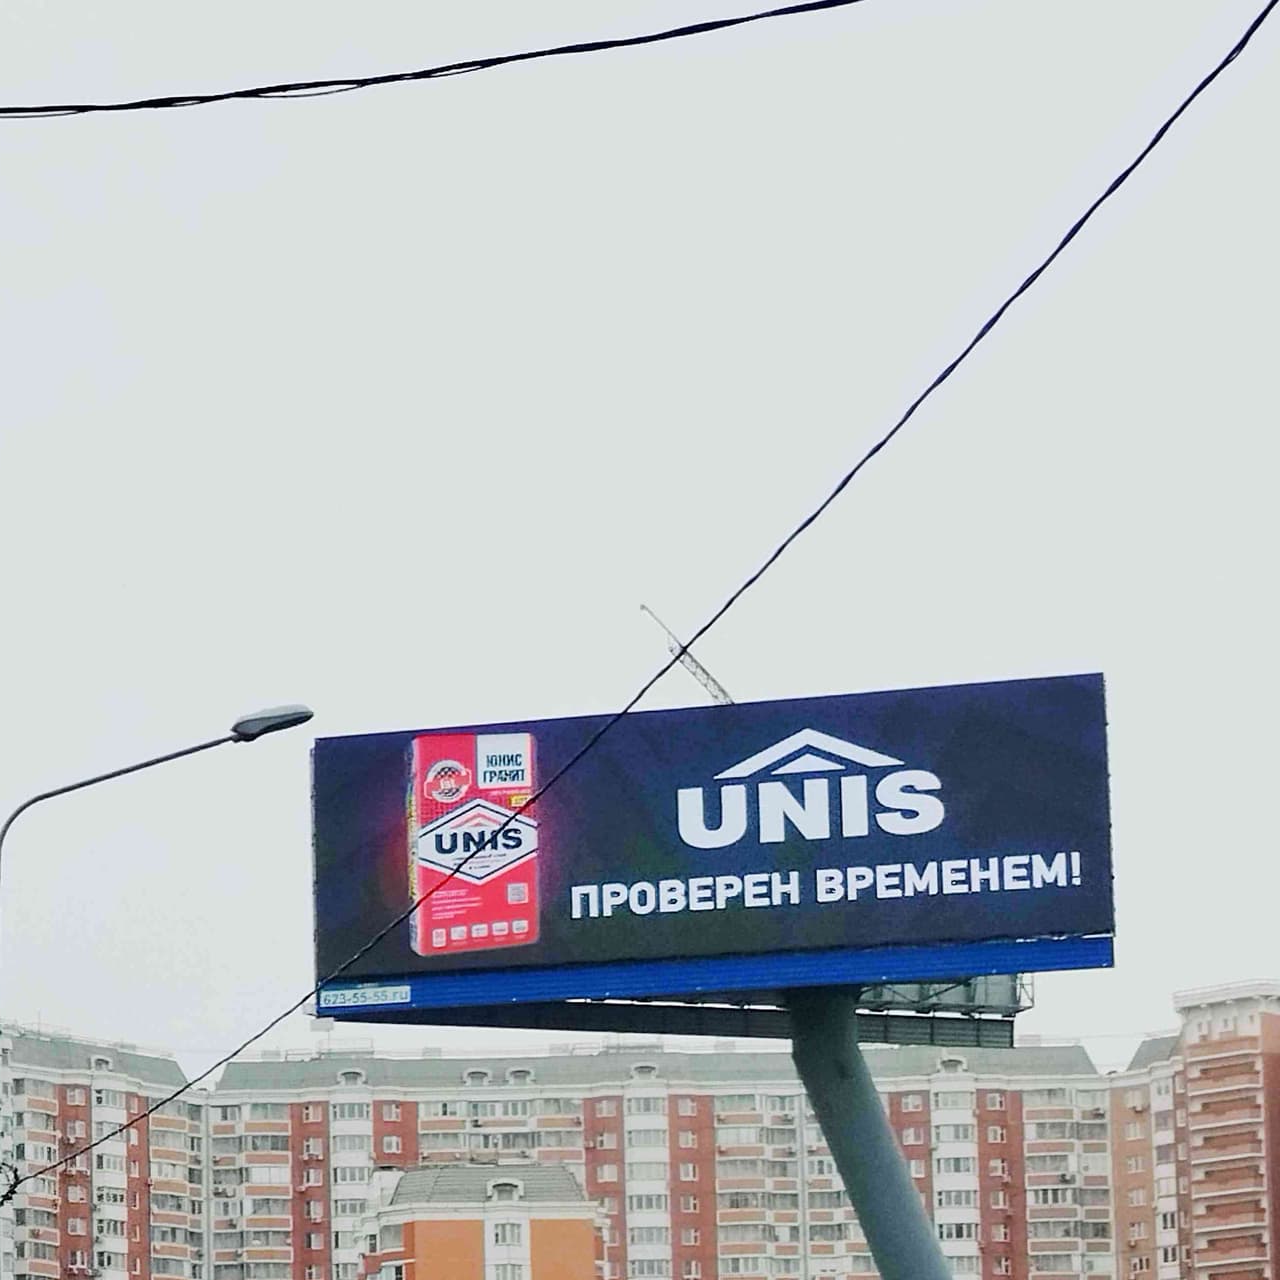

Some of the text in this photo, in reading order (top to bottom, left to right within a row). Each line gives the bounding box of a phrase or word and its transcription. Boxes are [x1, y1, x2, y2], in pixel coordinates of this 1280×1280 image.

[435, 828, 523, 854] UNIS
[677, 769, 946, 849] UNIS
[571, 851, 1083, 919] ПРОВЕРЕН ВРЕМЕНЕМ!
